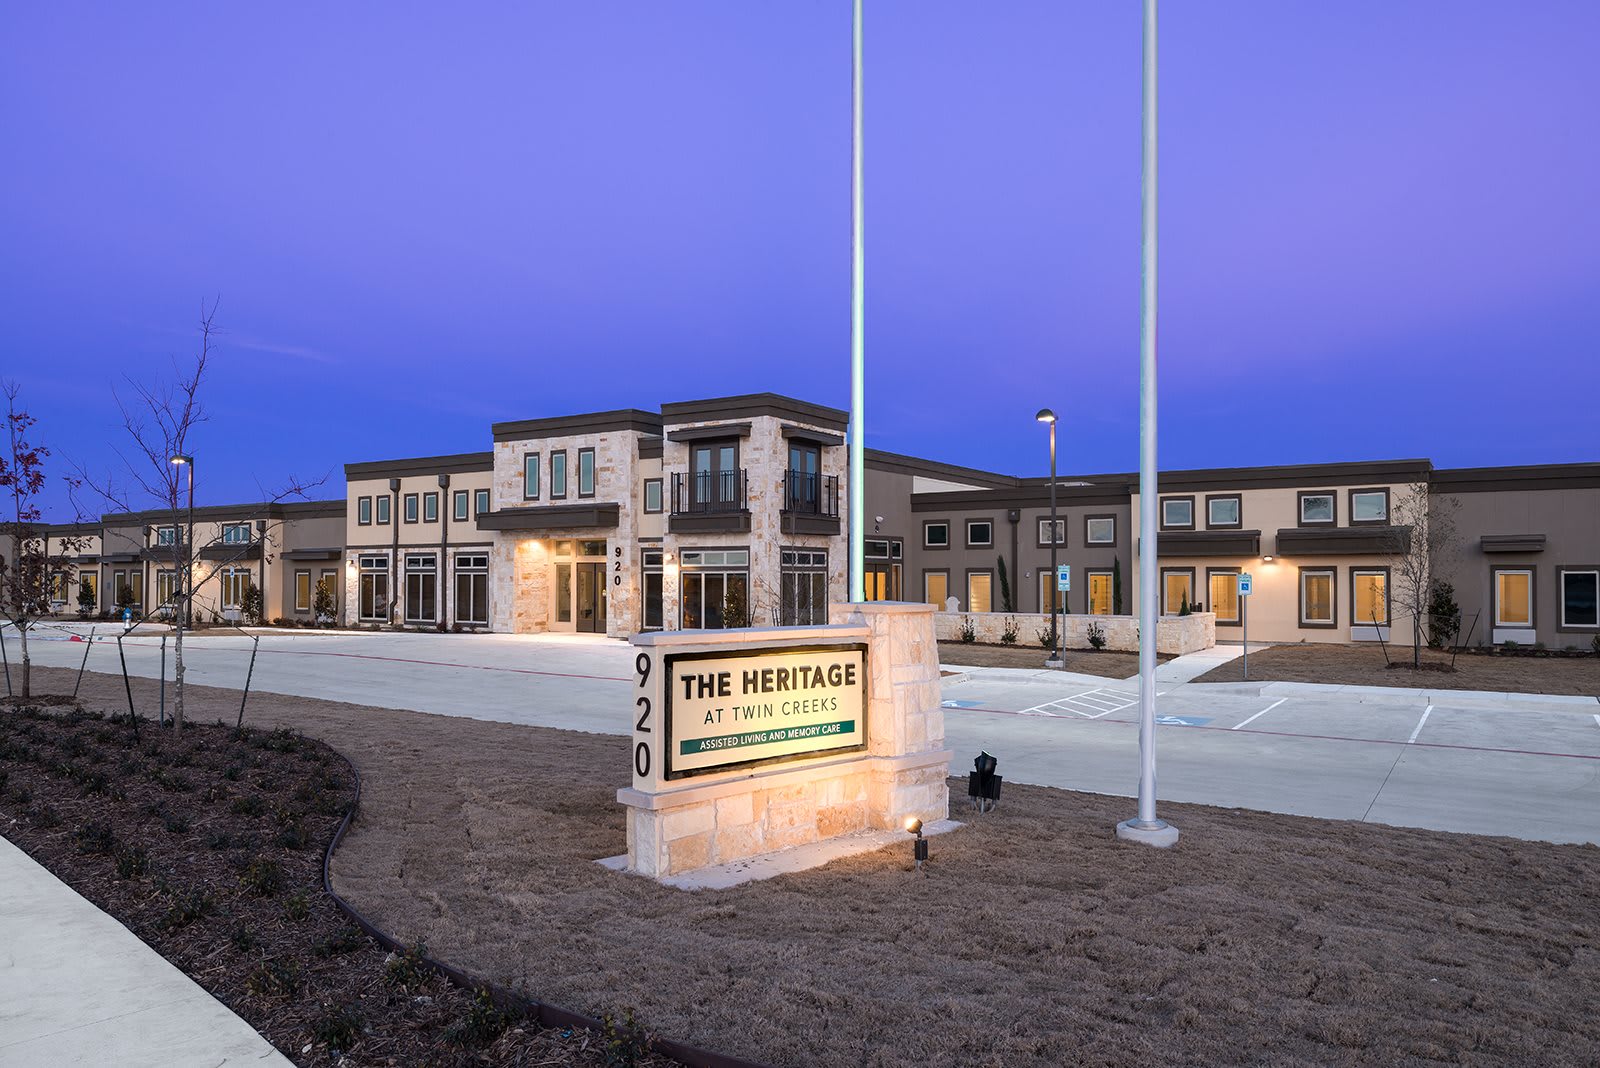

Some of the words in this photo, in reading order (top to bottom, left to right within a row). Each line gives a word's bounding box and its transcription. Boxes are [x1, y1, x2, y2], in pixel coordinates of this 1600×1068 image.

[614, 547, 622, 586] 920
[680, 671, 731, 700] THE
[742, 663, 856, 695] HERITAGE
[635, 652, 651, 778] 920
[704, 708, 724, 725] AT
[732, 703, 773, 721] TWIN
[782, 697, 838, 716] CREEKS
[700, 737, 739, 750] ASSISTED
[740, 733, 767, 745] LIVING
[769, 730, 786, 742] AND
[788, 726, 821, 739] MEMORY
[821, 723, 841, 734] CARE
